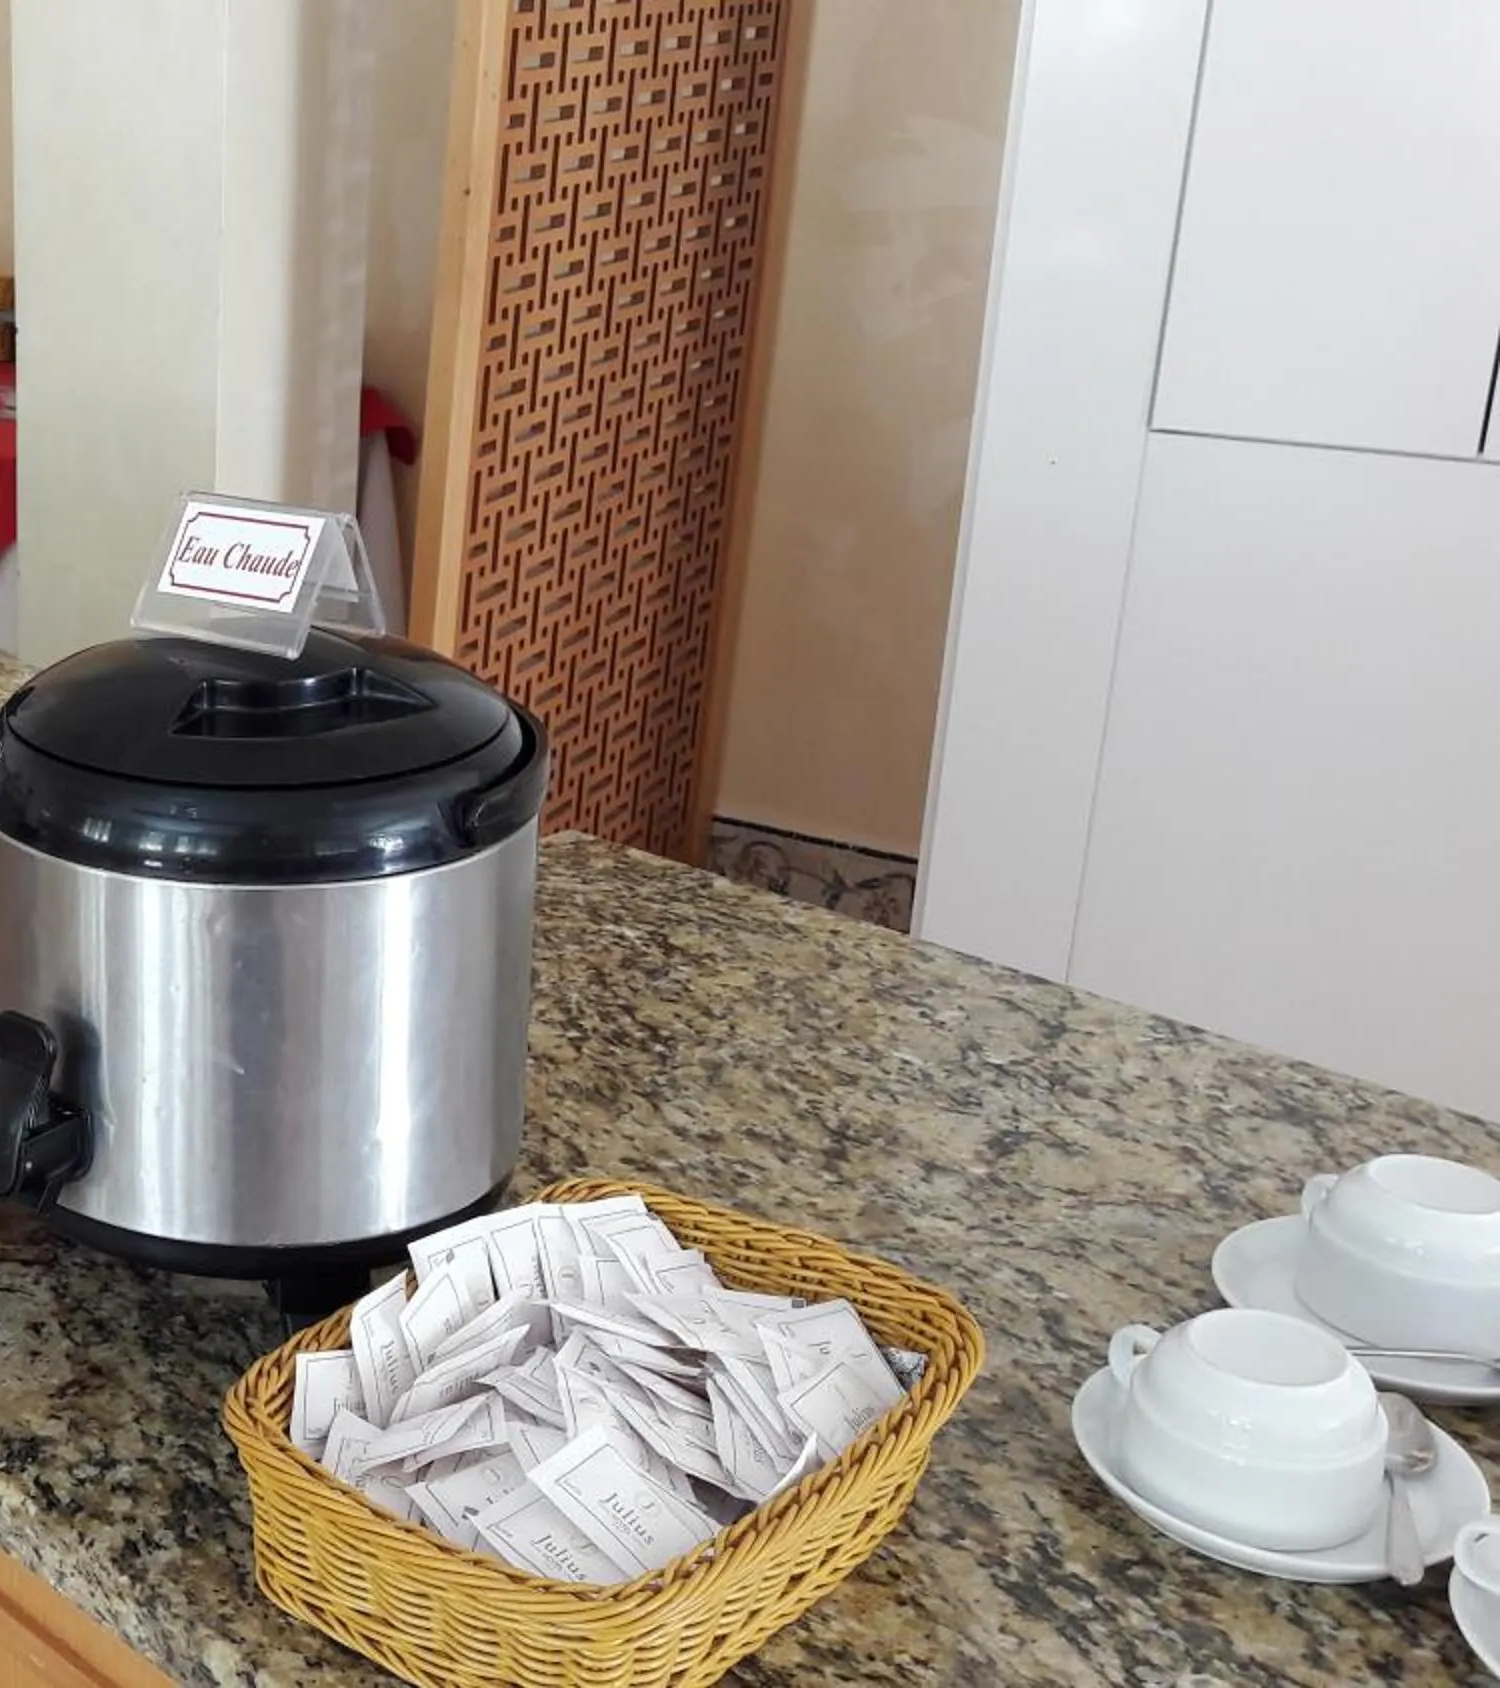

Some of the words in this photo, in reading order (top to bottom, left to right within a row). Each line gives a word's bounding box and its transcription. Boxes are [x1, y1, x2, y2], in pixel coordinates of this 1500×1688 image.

[178, 535, 217, 567] Eau
[223, 540, 301, 579] Chaude
[597, 1492, 656, 1546] Julius
[530, 1534, 588, 1581] Julius
